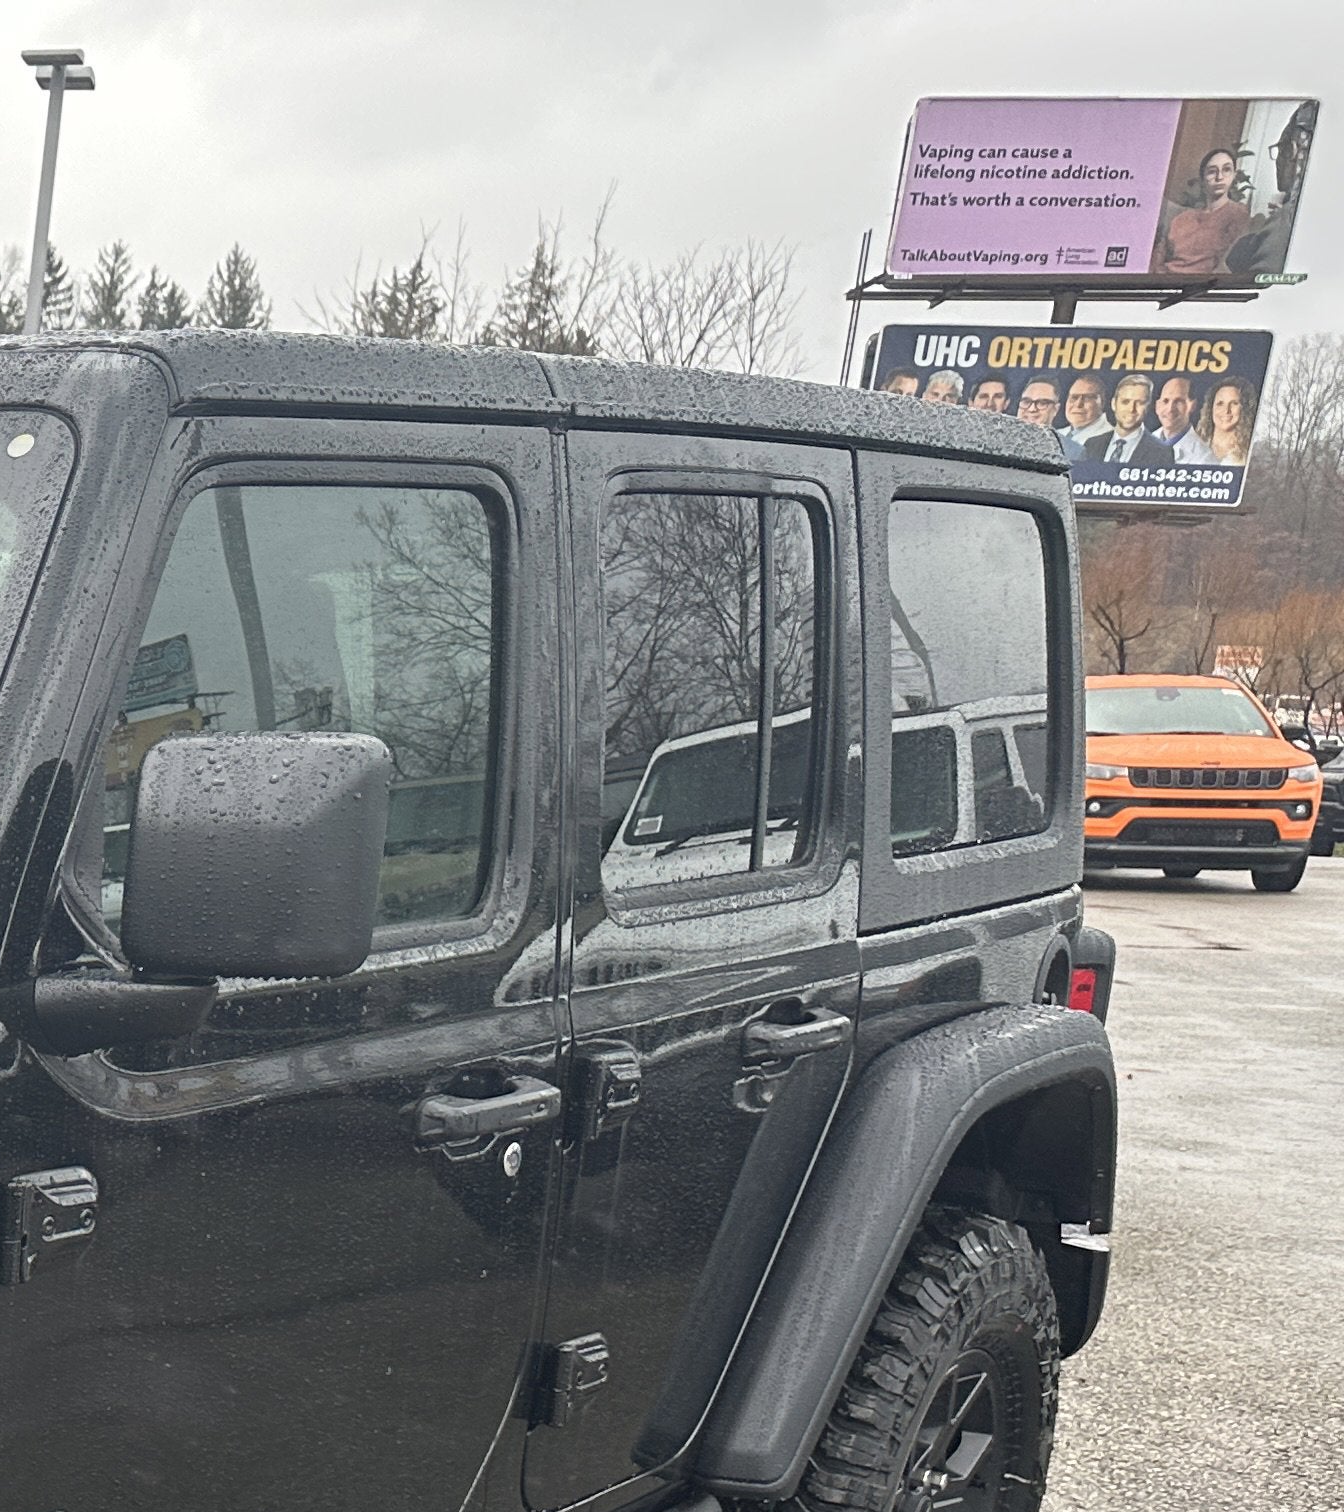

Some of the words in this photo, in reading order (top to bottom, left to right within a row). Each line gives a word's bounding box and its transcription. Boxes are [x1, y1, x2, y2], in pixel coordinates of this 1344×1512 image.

[918, 144, 974, 162] Vaping
[978, 148, 1006, 159] can
[1011, 148, 1059, 159] cause
[1062, 148, 1073, 159] a
[913, 164, 976, 182] lifelong
[979, 165, 1047, 180] nicotine
[1051, 165, 1134, 180] addiction.
[909, 192, 958, 207] That's
[962, 192, 1011, 207] worth
[1015, 196, 1025, 207] a
[1029, 193, 1141, 208] conversation.
[900, 249, 1049, 265] TalkAboutVaping.org
[913, 334, 981, 368] UHC
[987, 336, 1232, 373] ORTHOPAEDICS
[1119, 468, 1234, 484] 681-342-3500
[1072, 481, 1230, 500] orthocenter.com
